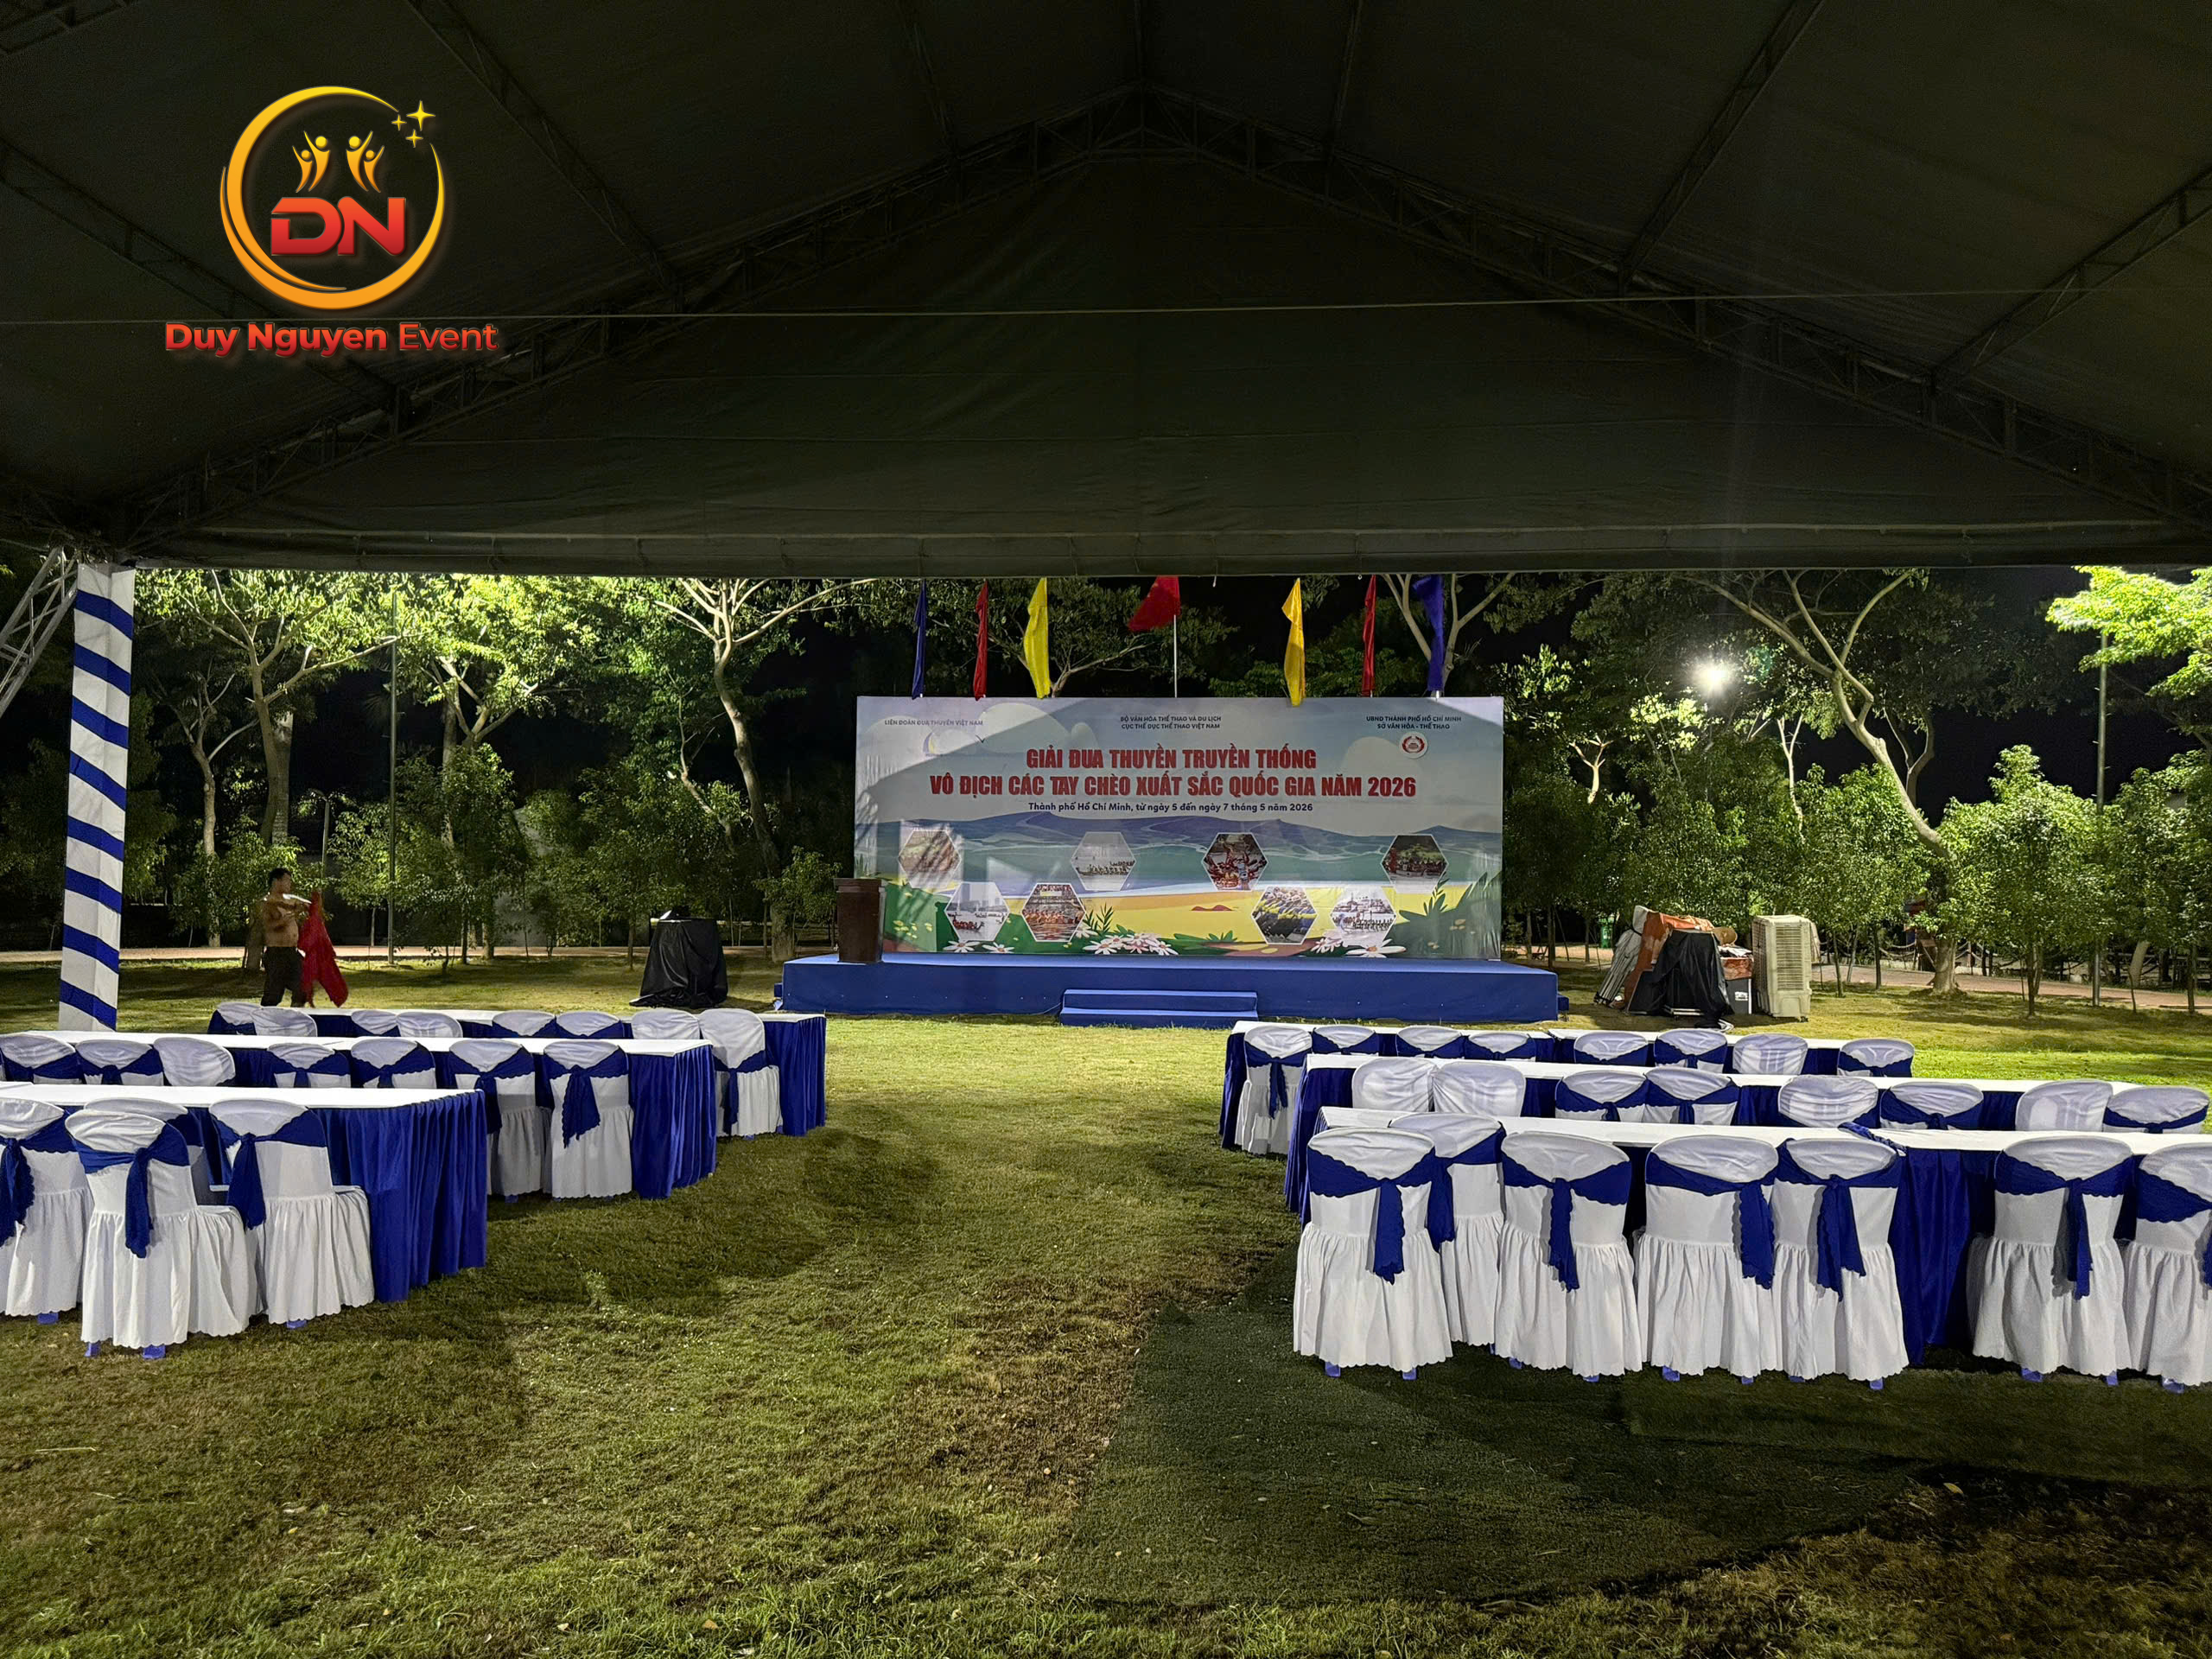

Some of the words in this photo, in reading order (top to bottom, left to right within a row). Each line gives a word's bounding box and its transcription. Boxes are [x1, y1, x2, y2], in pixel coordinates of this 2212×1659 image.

[1027, 744, 1063, 768] GIẢI
[1069, 749, 1103, 768] ĐUA
[1109, 743, 1177, 768] THUYỀN
[1182, 743, 1250, 769] TRUYỀN
[1255, 743, 1317, 769] THỐNG
[930, 772, 954, 795] VÔ
[959, 775, 1002, 798] ĐỊCH
[1008, 772, 1044, 795] CÁC
[1050, 776, 1079, 795] TAY
[1084, 772, 1131, 796] CHÈO
[1135, 770, 1183, 796] XUẤT
[1187, 770, 1224, 796] SẮC
[1230, 770, 1279, 798] QUỐC
[1285, 776, 1316, 796] GIA
[1321, 773, 1362, 797] NĂM
[1368, 777, 1416, 797] 2026
[1028, 802, 1056, 810] Thành
[1058, 801, 1077, 812] phố
[1092, 802, 1106, 810] Chí
[1109, 802, 1134, 812] Minh,
[1135, 802, 1147, 810] từ
[1147, 804, 1169, 812] ngày
[1179, 802, 1196, 810] đến
[1198, 804, 1221, 812] ngày
[1230, 803, 1257, 812] tháng
